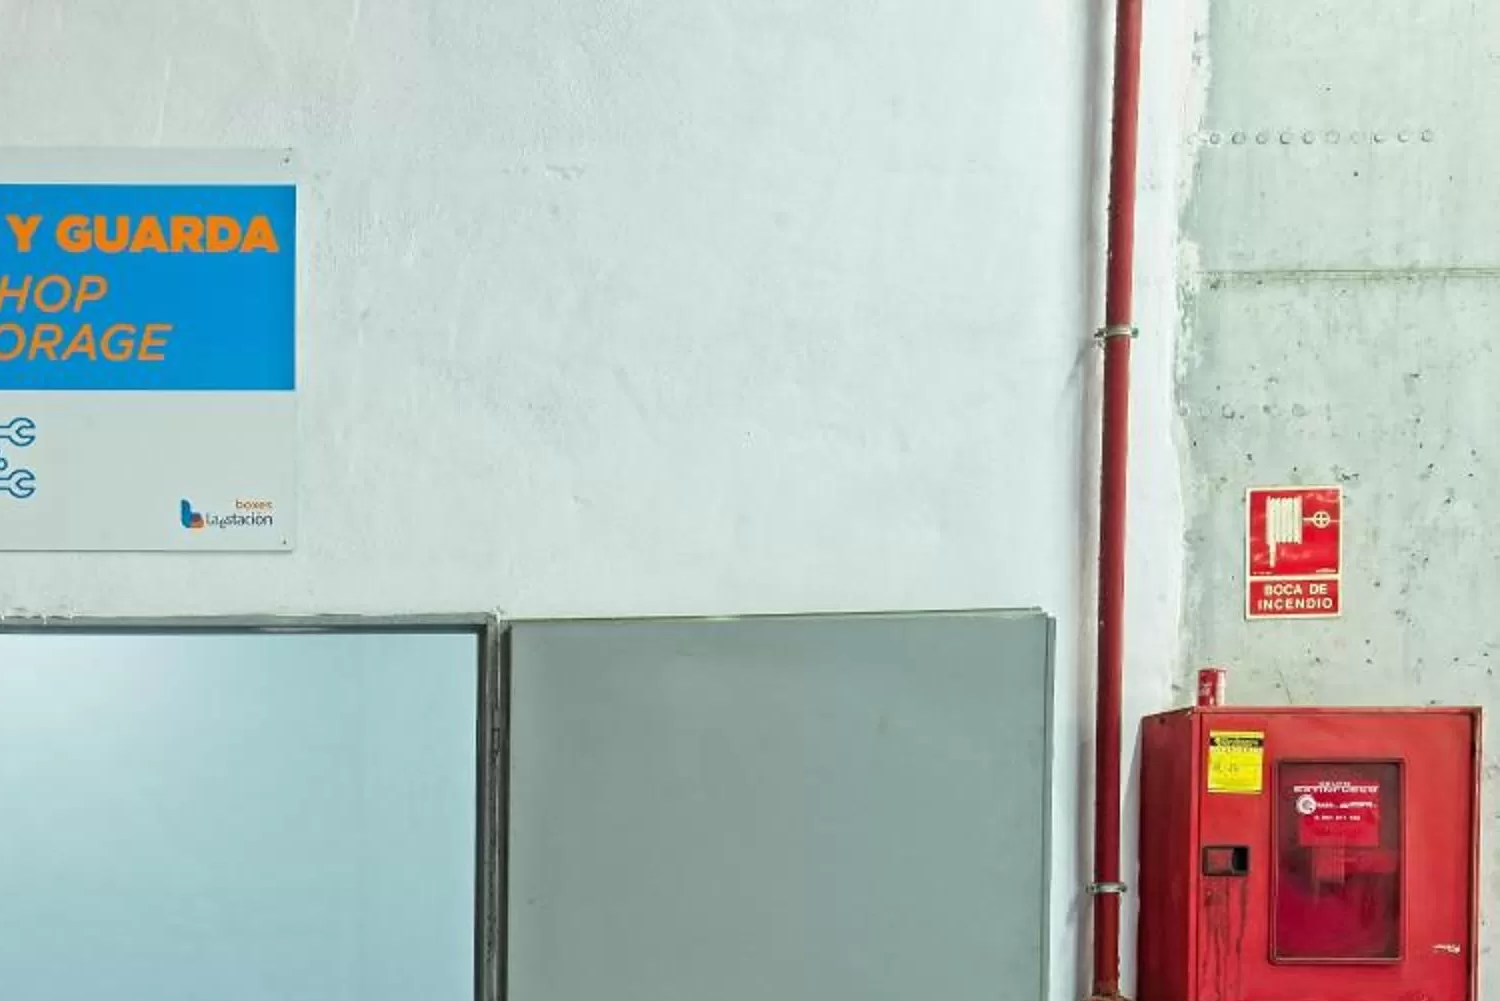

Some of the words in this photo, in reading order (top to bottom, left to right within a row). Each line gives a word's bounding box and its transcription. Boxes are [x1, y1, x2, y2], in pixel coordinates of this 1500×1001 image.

[6, 214, 42, 252] Y
[56, 214, 280, 254] GUARDA
[235, 499, 272, 509] boxes
[1264, 583, 1303, 596] BOCA
[1309, 583, 1328, 595] DE
[1258, 597, 1333, 610] INCENDIO
